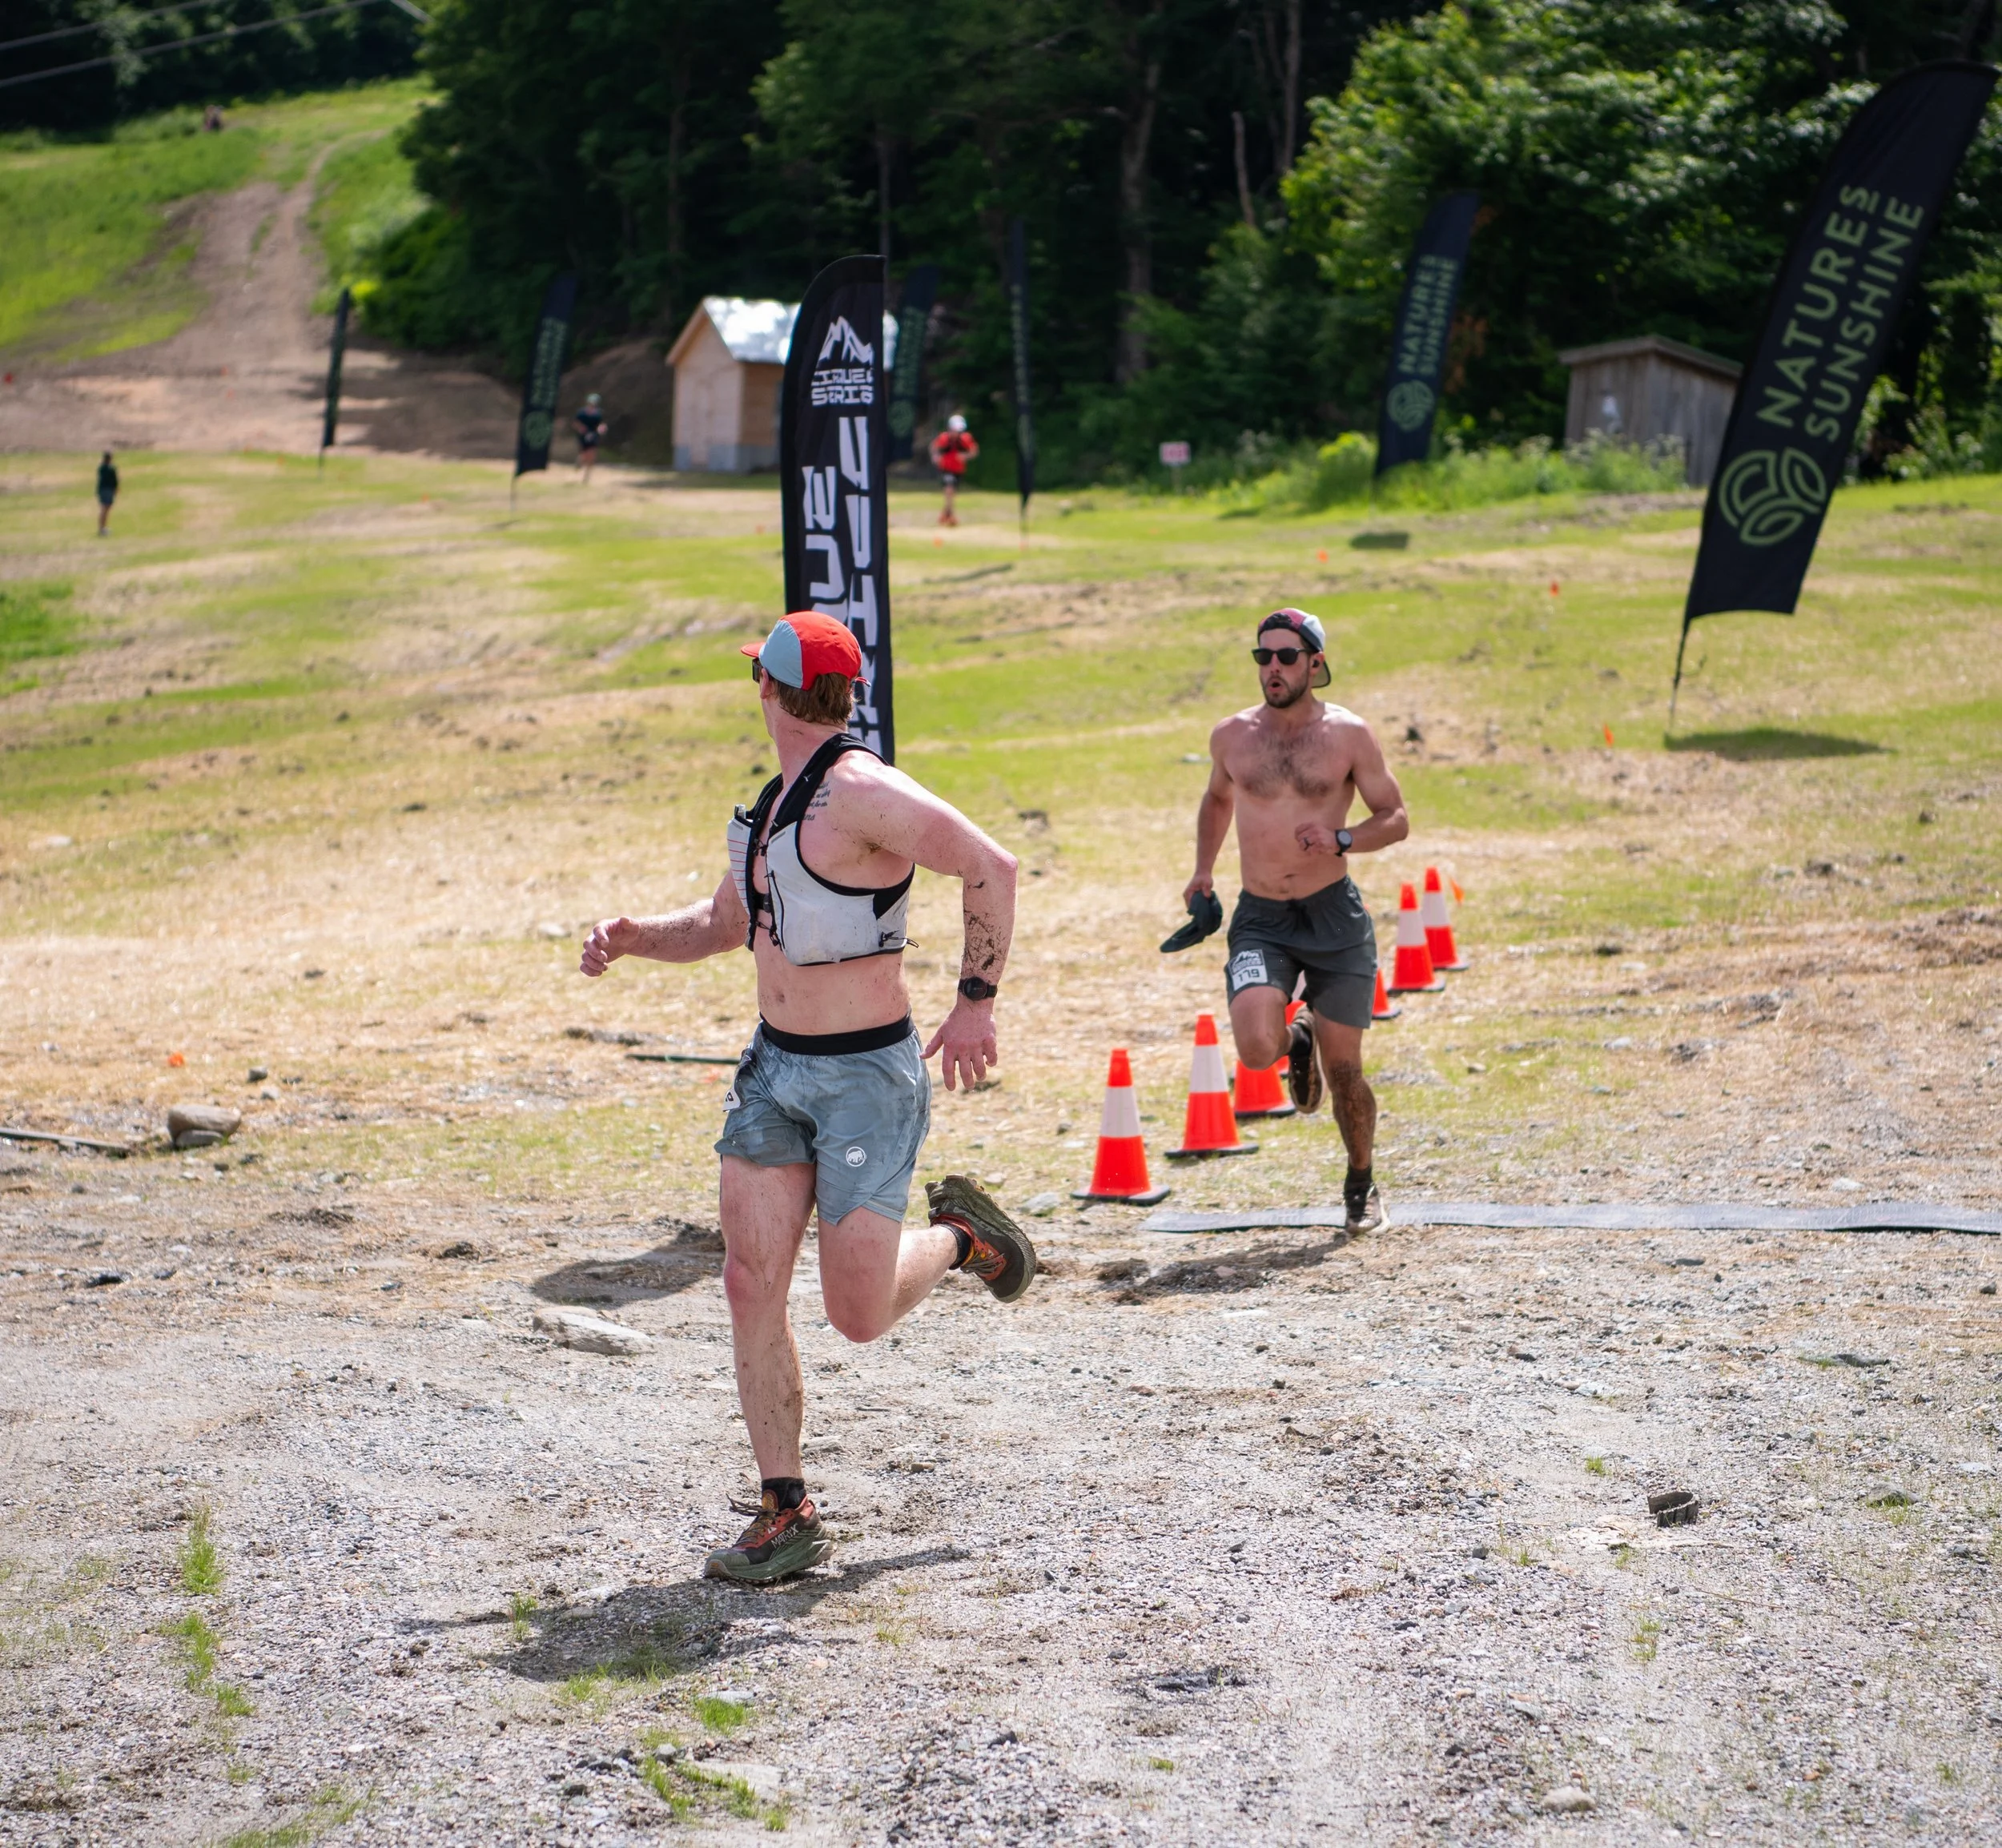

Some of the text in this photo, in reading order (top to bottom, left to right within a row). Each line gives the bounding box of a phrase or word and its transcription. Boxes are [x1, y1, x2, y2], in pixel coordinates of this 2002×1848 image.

[1804, 196, 1925, 443] SUNSHINE
[1238, 969, 1260, 981] 179
[770, 1523, 799, 1549] MATRYX
